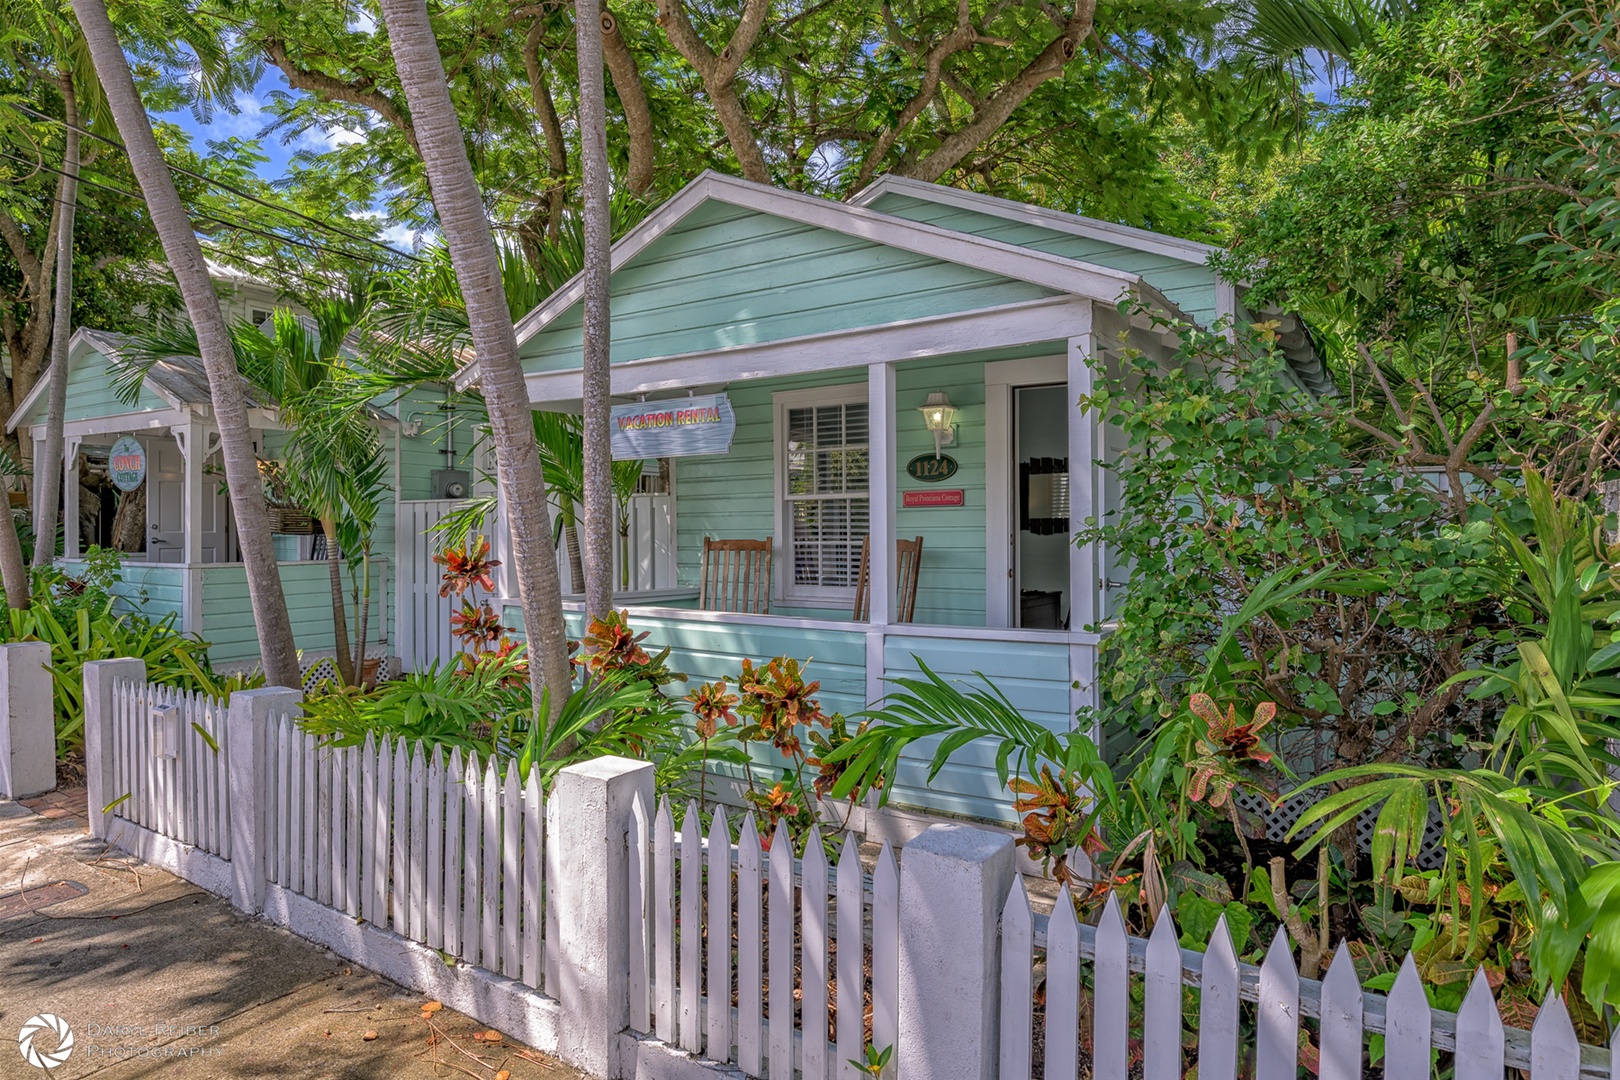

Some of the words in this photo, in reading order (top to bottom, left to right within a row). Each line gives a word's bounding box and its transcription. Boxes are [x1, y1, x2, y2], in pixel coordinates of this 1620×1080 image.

[617, 411, 673, 430] VACATION
[677, 407, 721, 425] RENTAL
[113, 455, 140, 470] CONCH
[916, 459, 948, 476] 1124
[905, 495, 918, 503] Royal
[919, 494, 940, 502] Poinciana
[942, 494, 960, 503] Cottage
